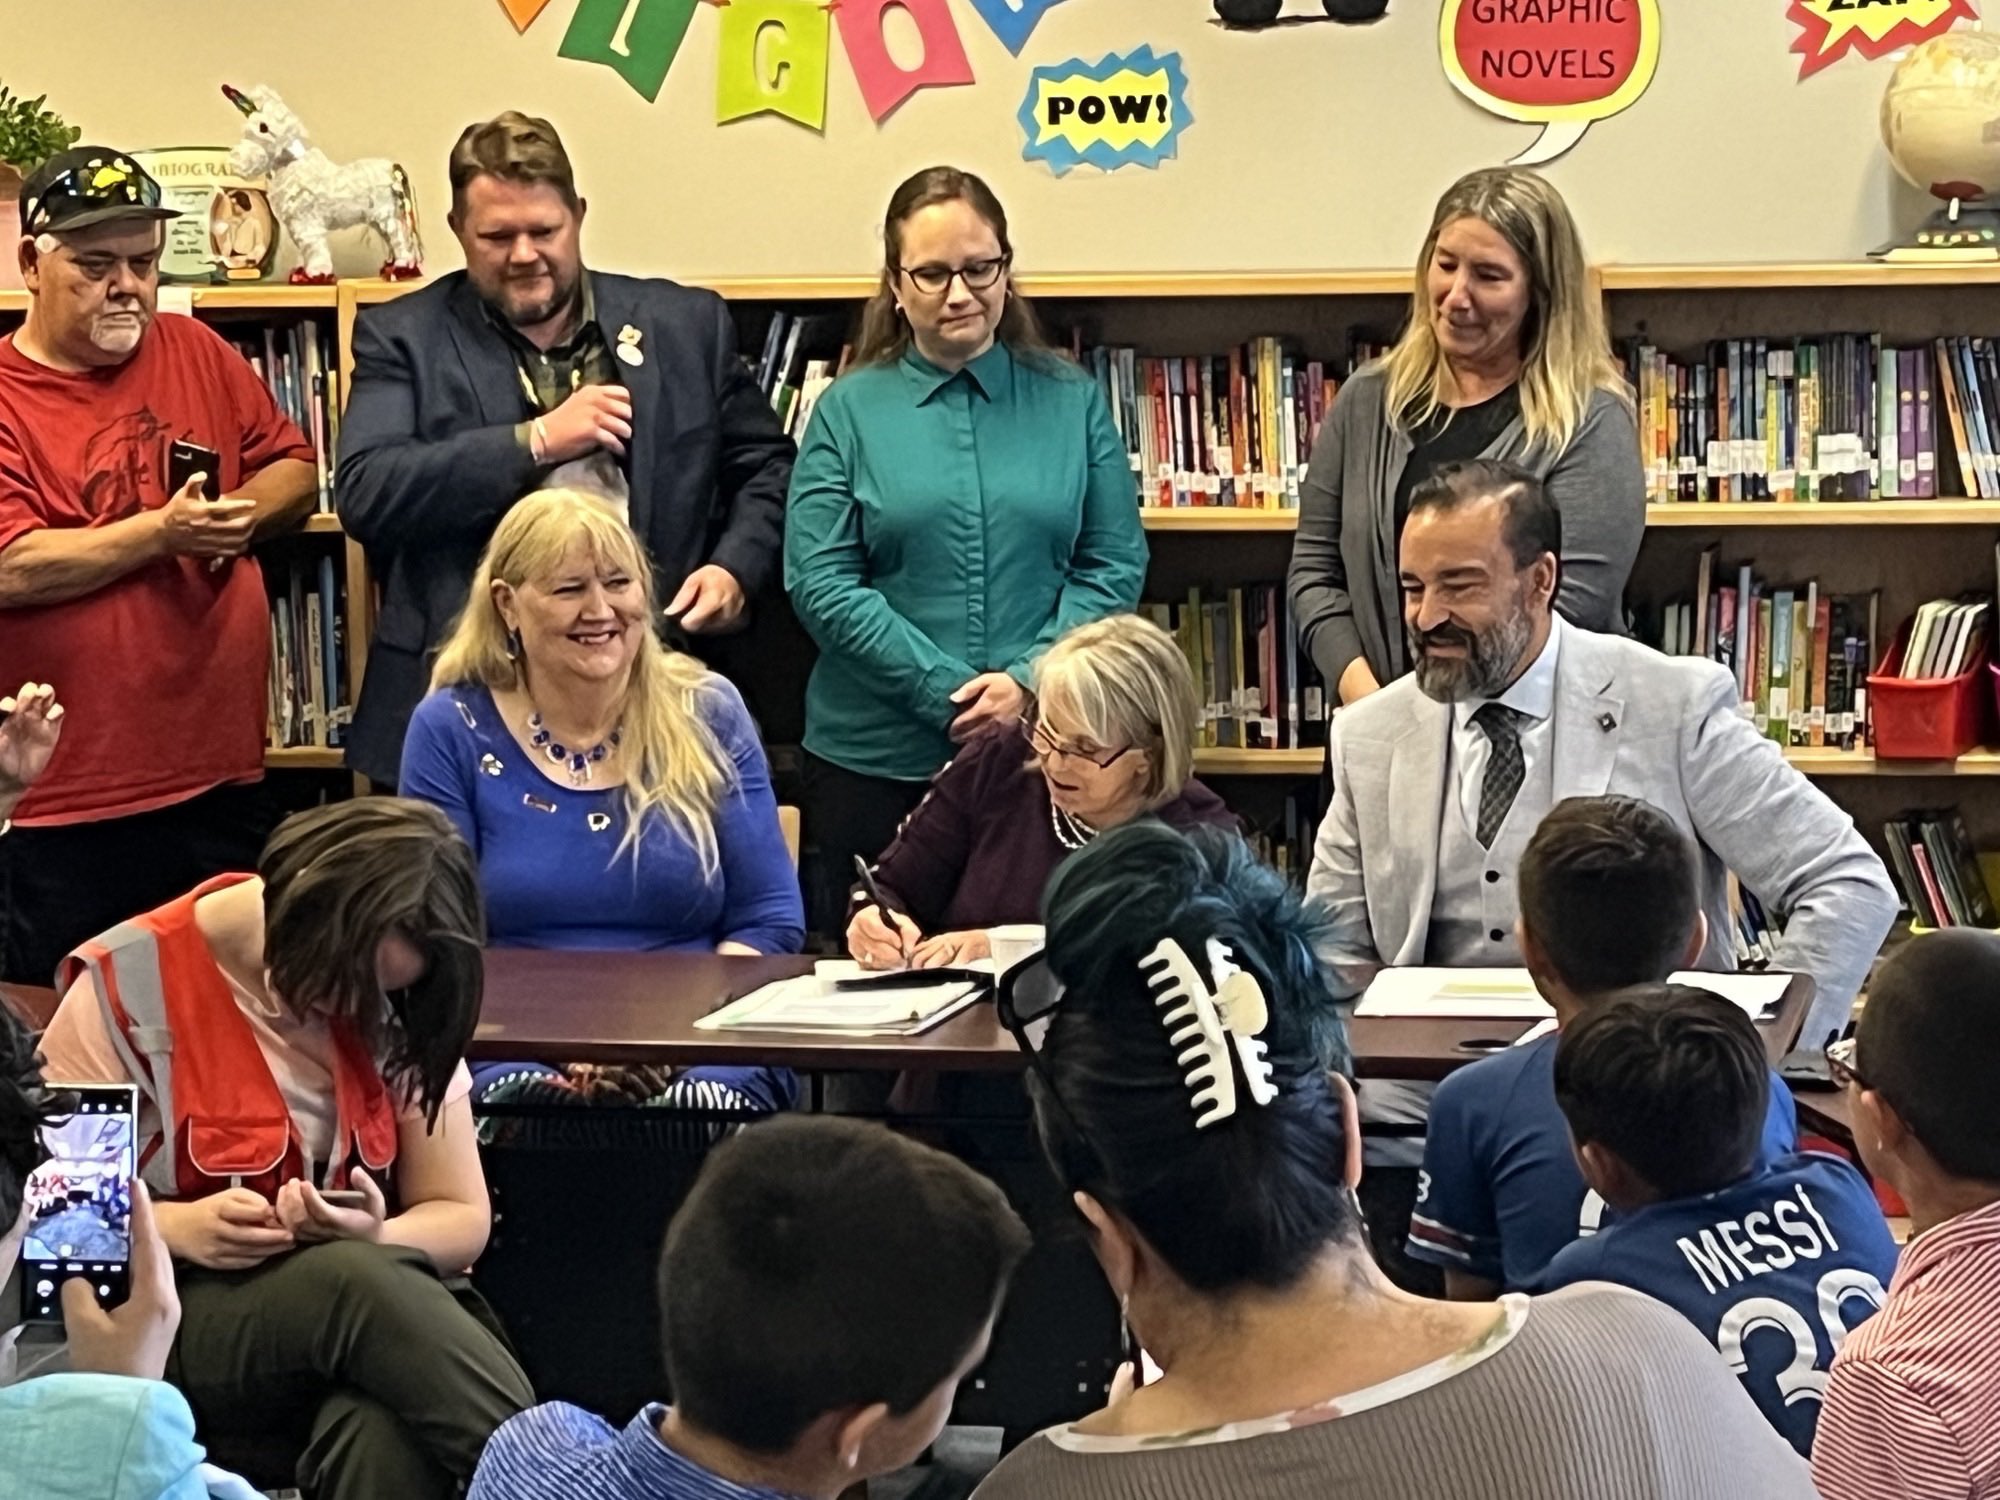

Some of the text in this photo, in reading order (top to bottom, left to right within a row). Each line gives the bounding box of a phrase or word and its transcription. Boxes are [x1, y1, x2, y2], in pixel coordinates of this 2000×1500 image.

[1472, 0, 1627, 23] GRAPHIC
[1481, 50, 1615, 78] NOVELS
[1047, 94, 1167, 125] POW!
